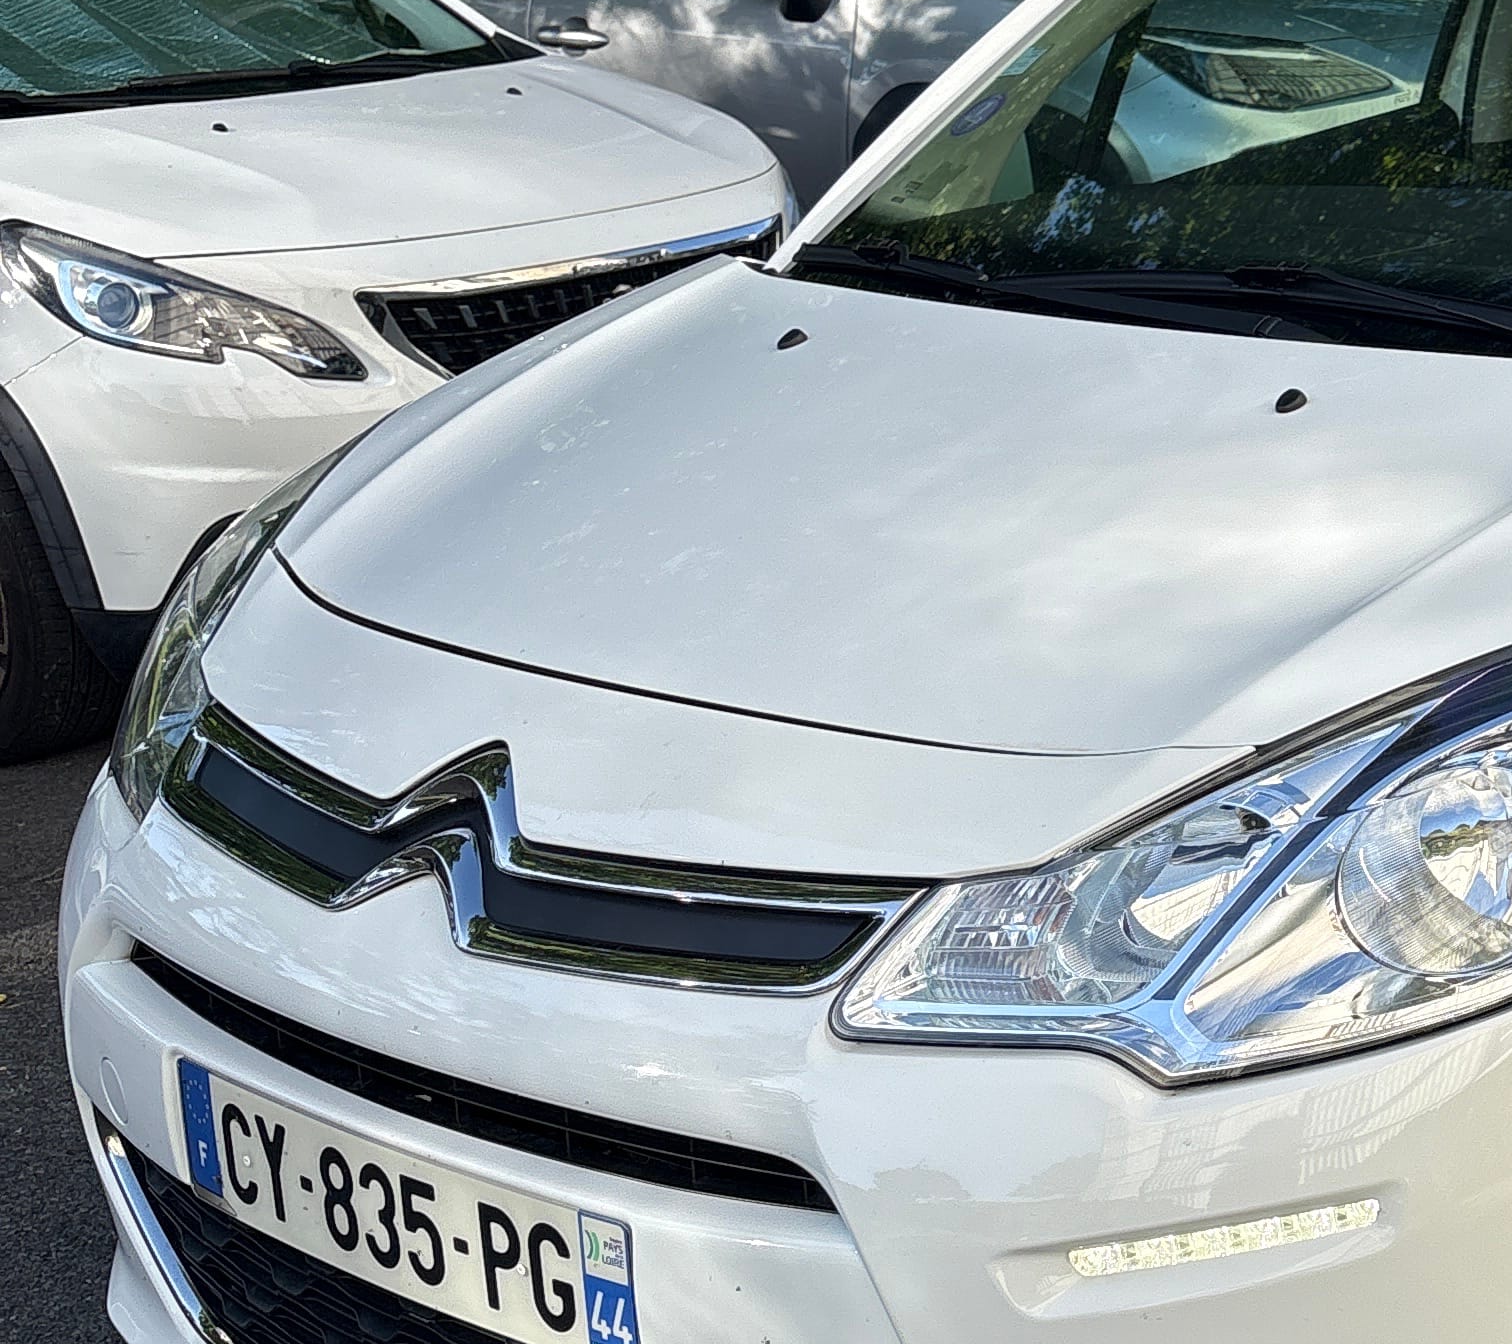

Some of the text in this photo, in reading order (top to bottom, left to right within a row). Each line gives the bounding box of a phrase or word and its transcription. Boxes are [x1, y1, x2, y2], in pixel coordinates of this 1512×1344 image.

[198, 1140, 208, 1167] F
[221, 1102, 577, 1333] CY-835-PG
[603, 1241, 624, 1254] PAYS
